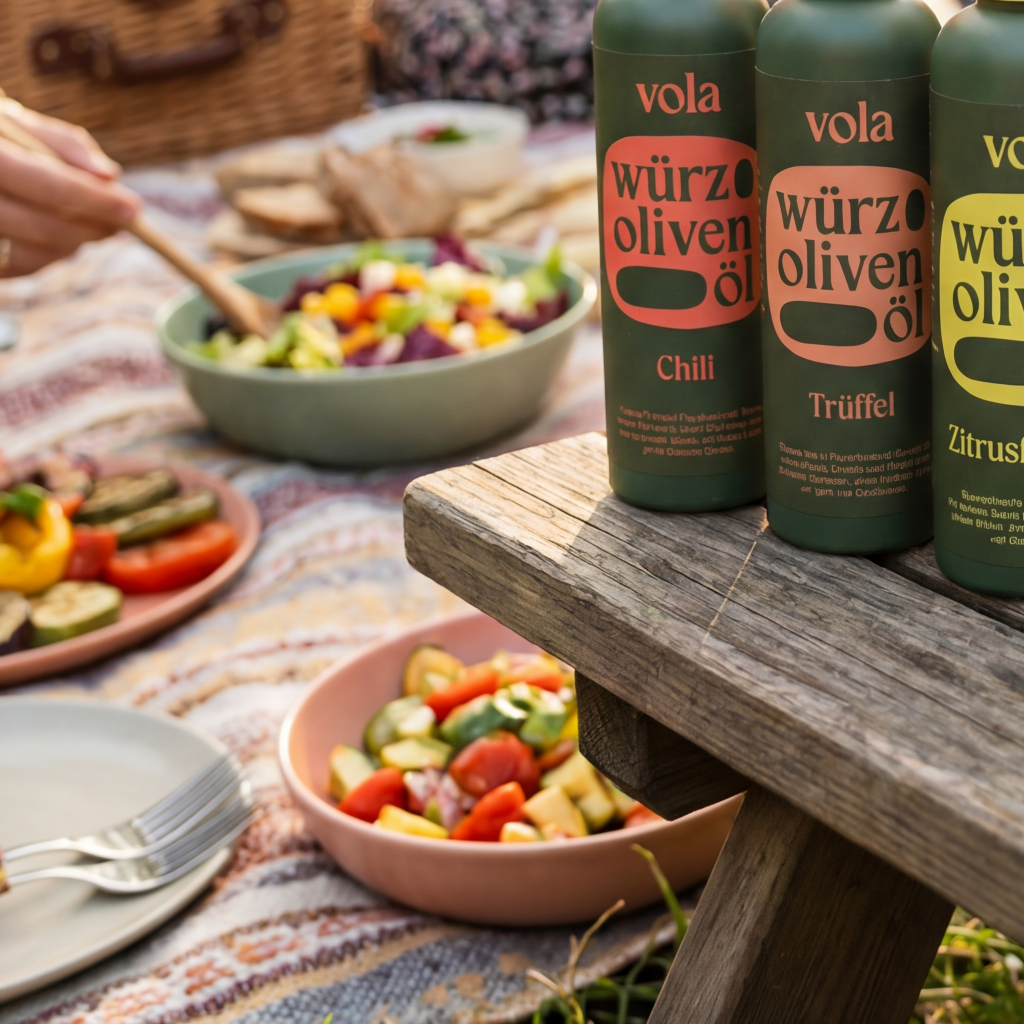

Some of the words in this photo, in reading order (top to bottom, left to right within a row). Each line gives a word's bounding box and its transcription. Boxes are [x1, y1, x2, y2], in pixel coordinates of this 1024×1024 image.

[636, 73, 721, 114] vola
[805, 101, 893, 144] vola
[611, 155, 729, 202] würz
[614, 206, 752, 256] oliven
[776, 186, 900, 235] würz
[714, 253, 755, 307] öl
[778, 239, 922, 291] oliven
[884, 289, 924, 342] öl
[657, 355, 713, 380] Chili
[809, 392, 894, 419] Trüffel
